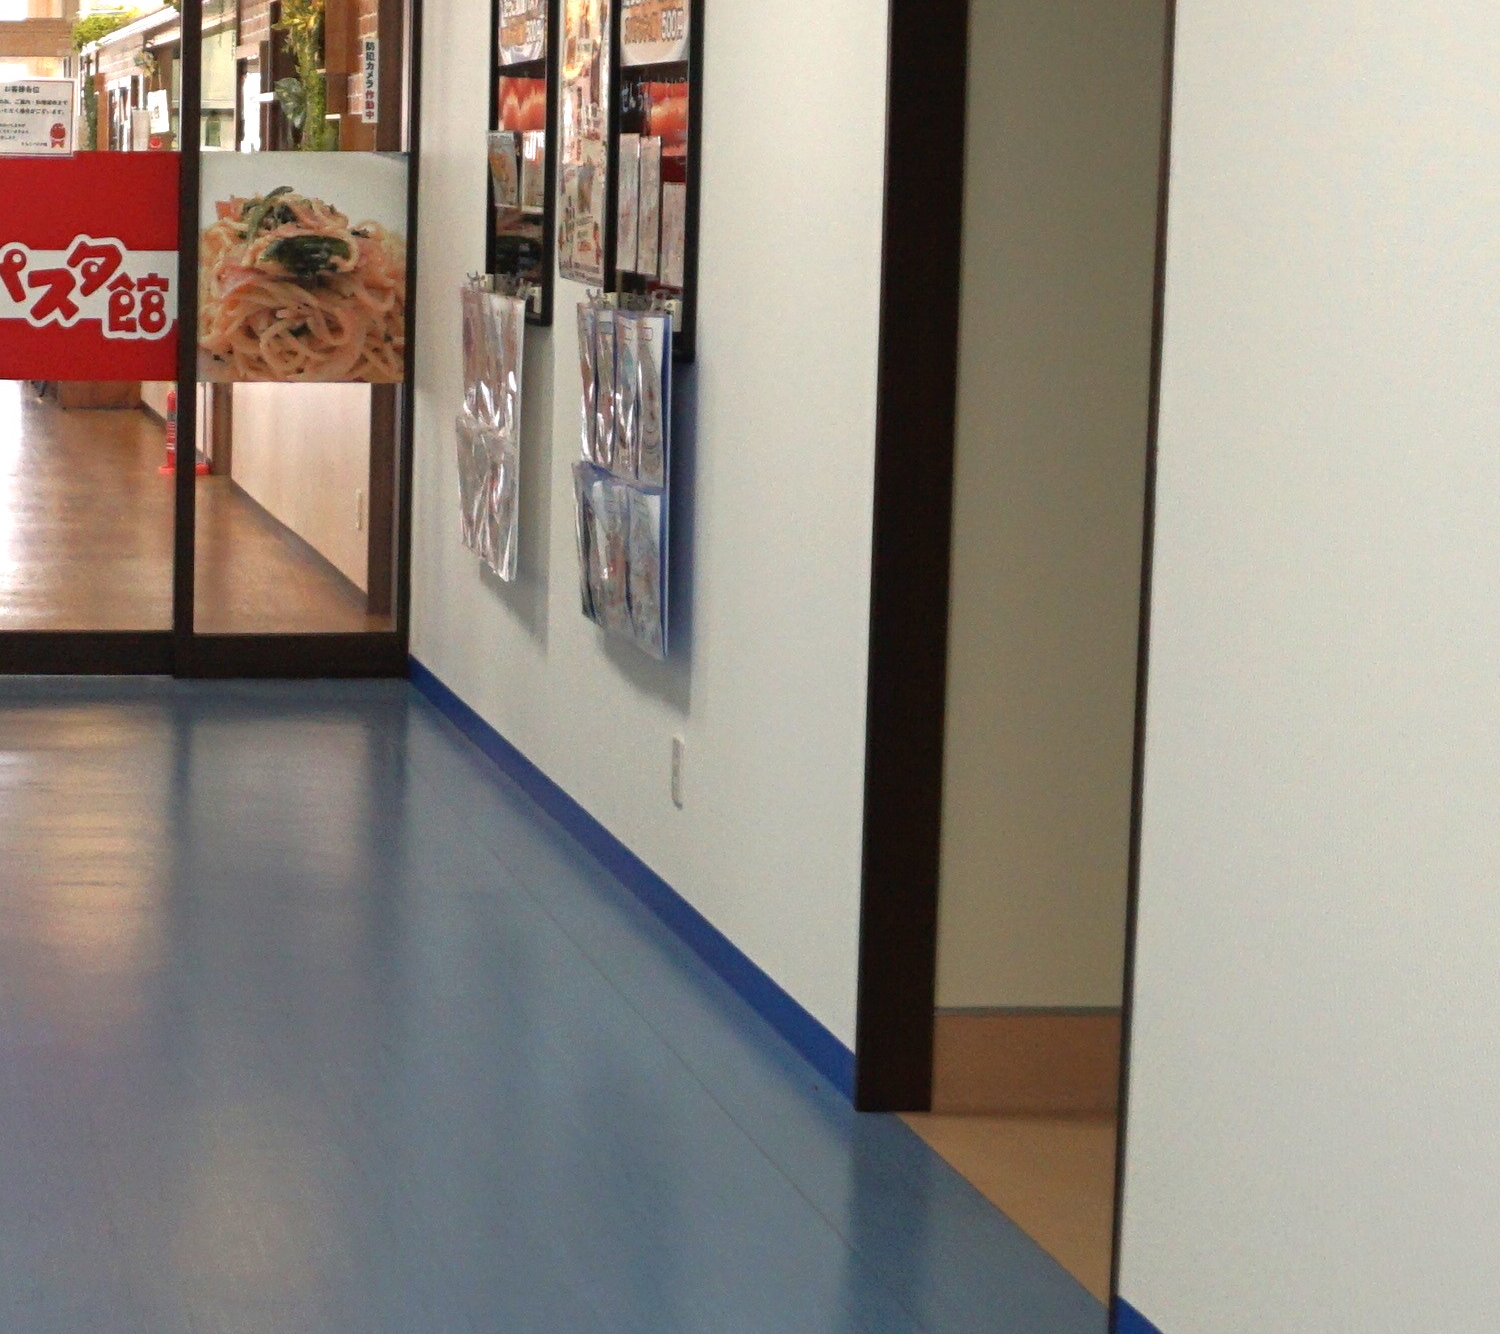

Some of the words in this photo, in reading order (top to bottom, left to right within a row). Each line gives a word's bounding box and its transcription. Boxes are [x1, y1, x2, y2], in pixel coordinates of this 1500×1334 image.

[365, 41, 375, 120] 防犯カメラ作動中
